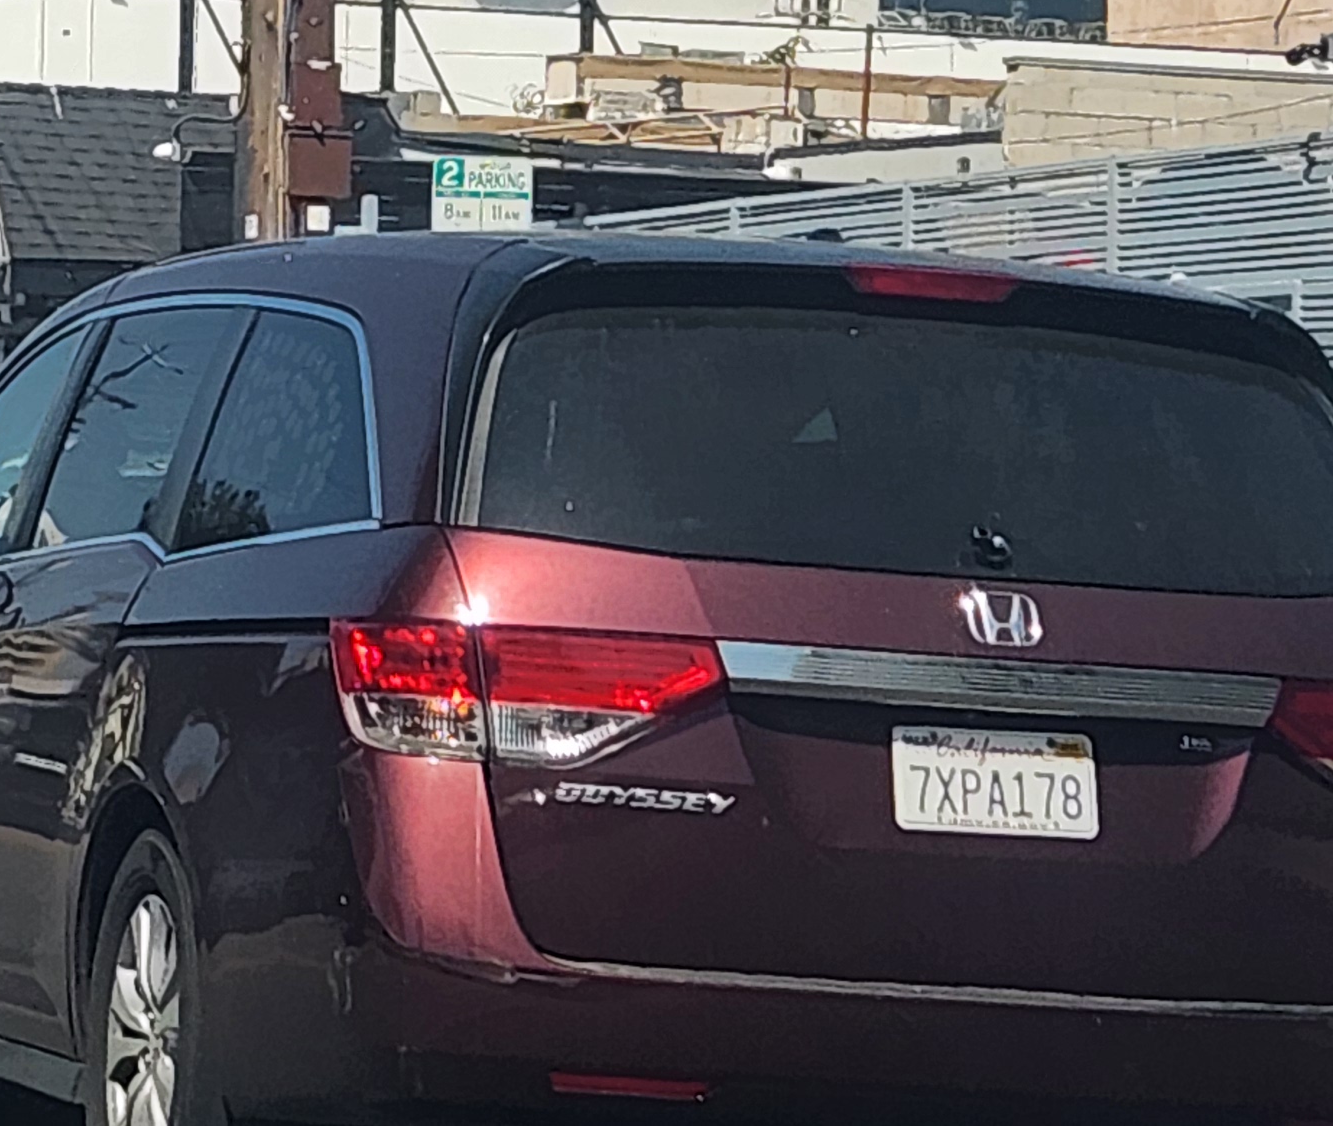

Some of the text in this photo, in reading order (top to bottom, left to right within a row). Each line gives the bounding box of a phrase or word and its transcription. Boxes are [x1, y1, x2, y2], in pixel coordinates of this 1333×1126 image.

[441, 160, 460, 187] 2
[468, 170, 527, 190] PARKING
[555, 781, 736, 814] ODYSSEY
[909, 764, 1084, 821] 7XPA178
